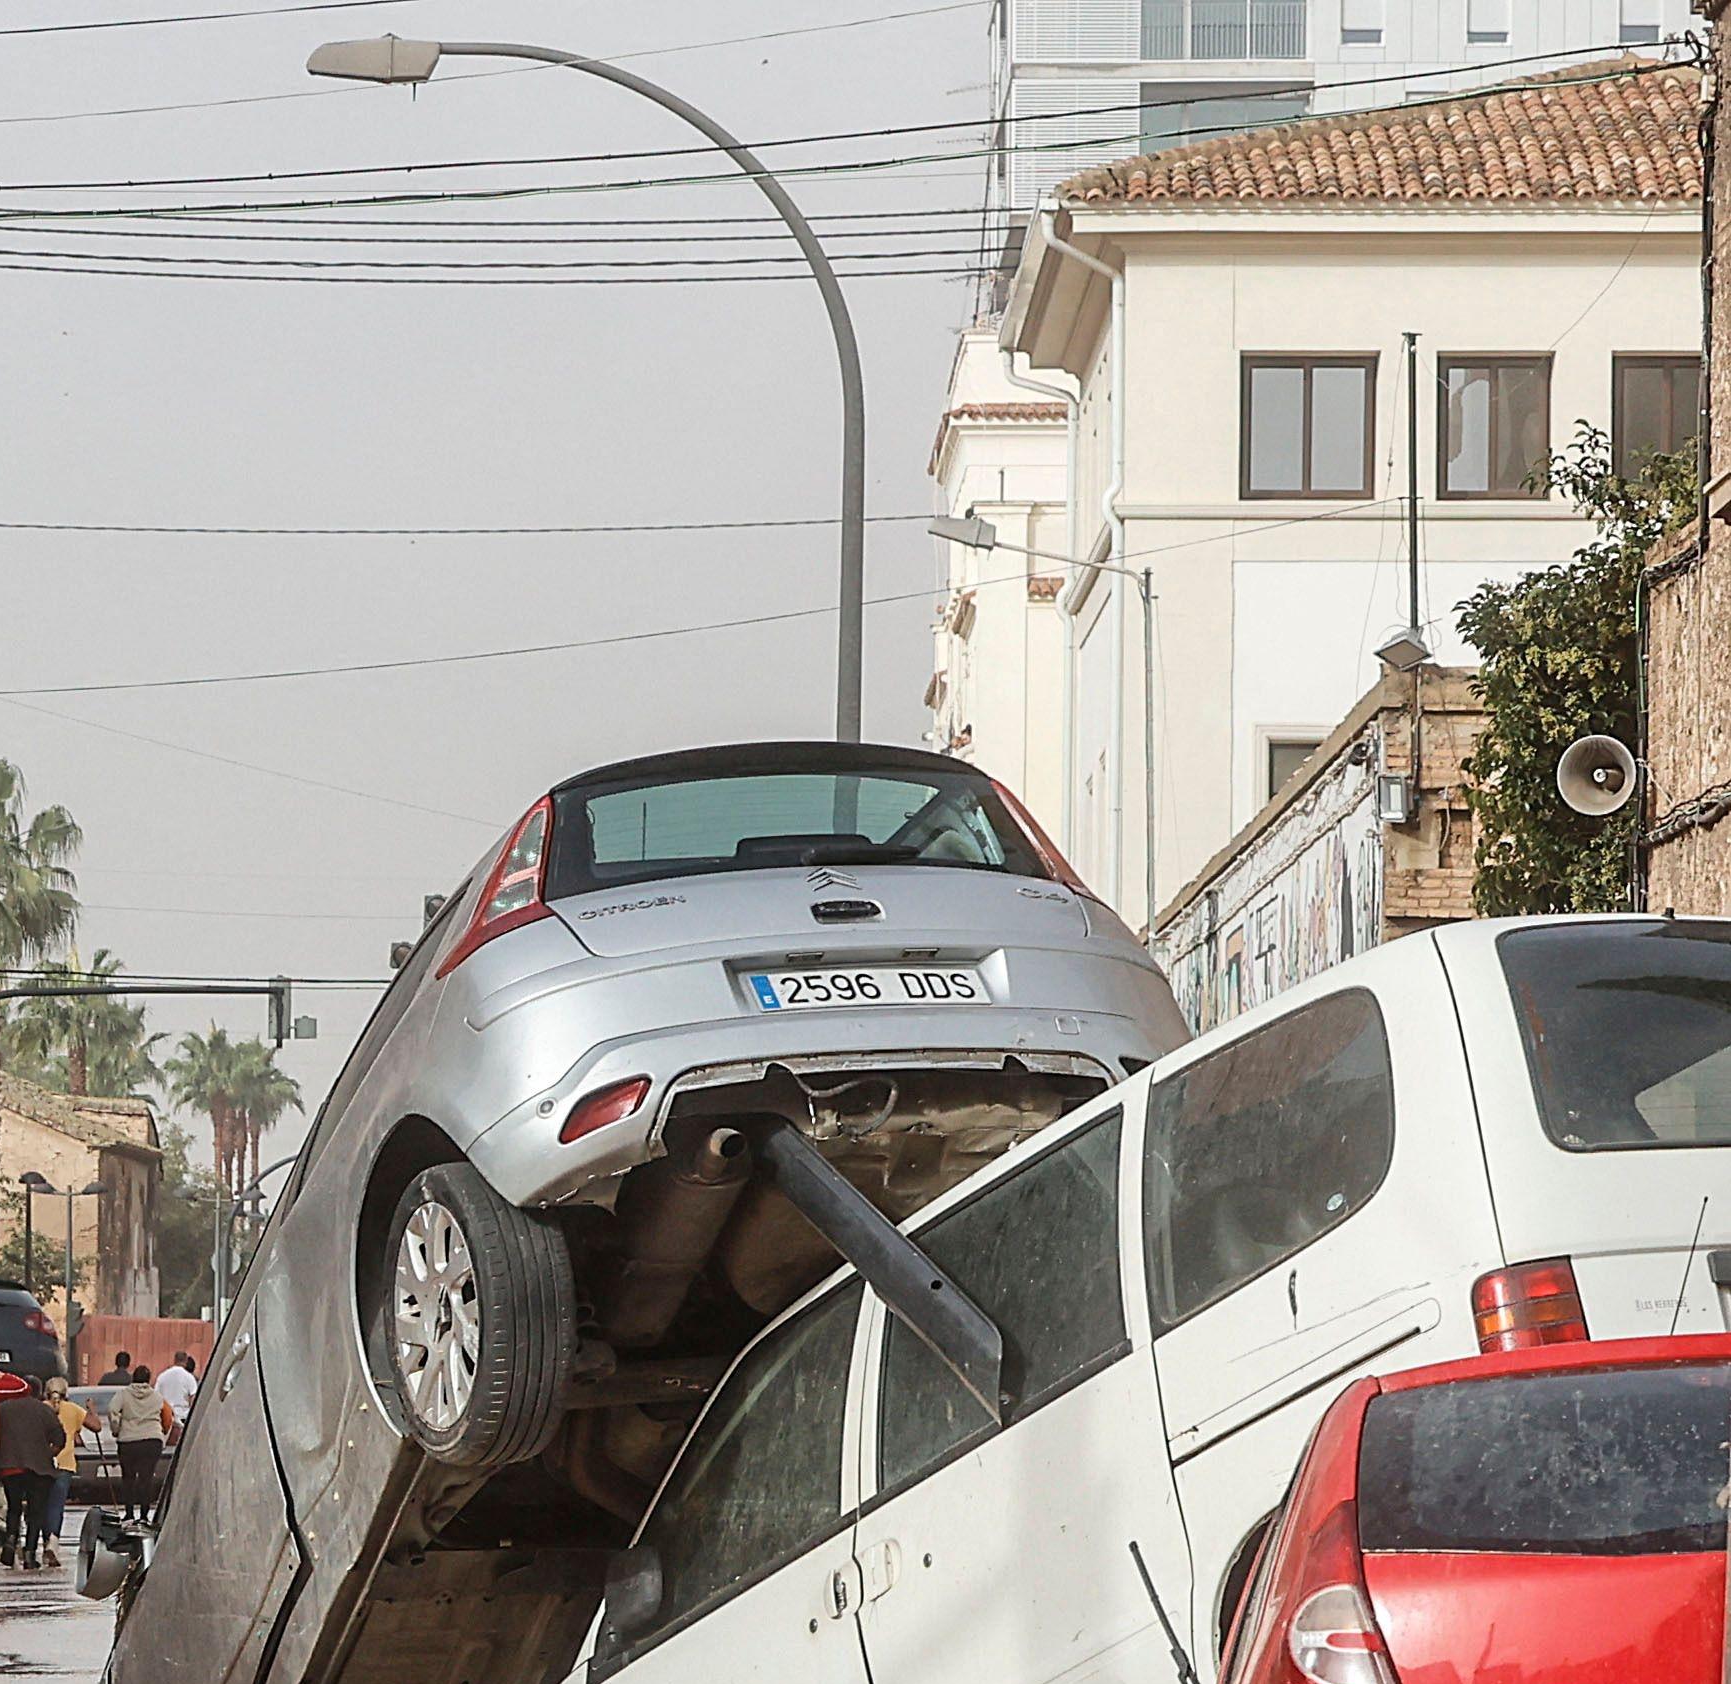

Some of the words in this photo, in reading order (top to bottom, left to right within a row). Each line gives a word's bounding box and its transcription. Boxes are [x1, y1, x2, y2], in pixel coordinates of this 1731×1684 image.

[1016, 888, 1069, 904] C4
[780, 973, 881, 1004] 2596
[898, 972, 976, 1000] DDS
